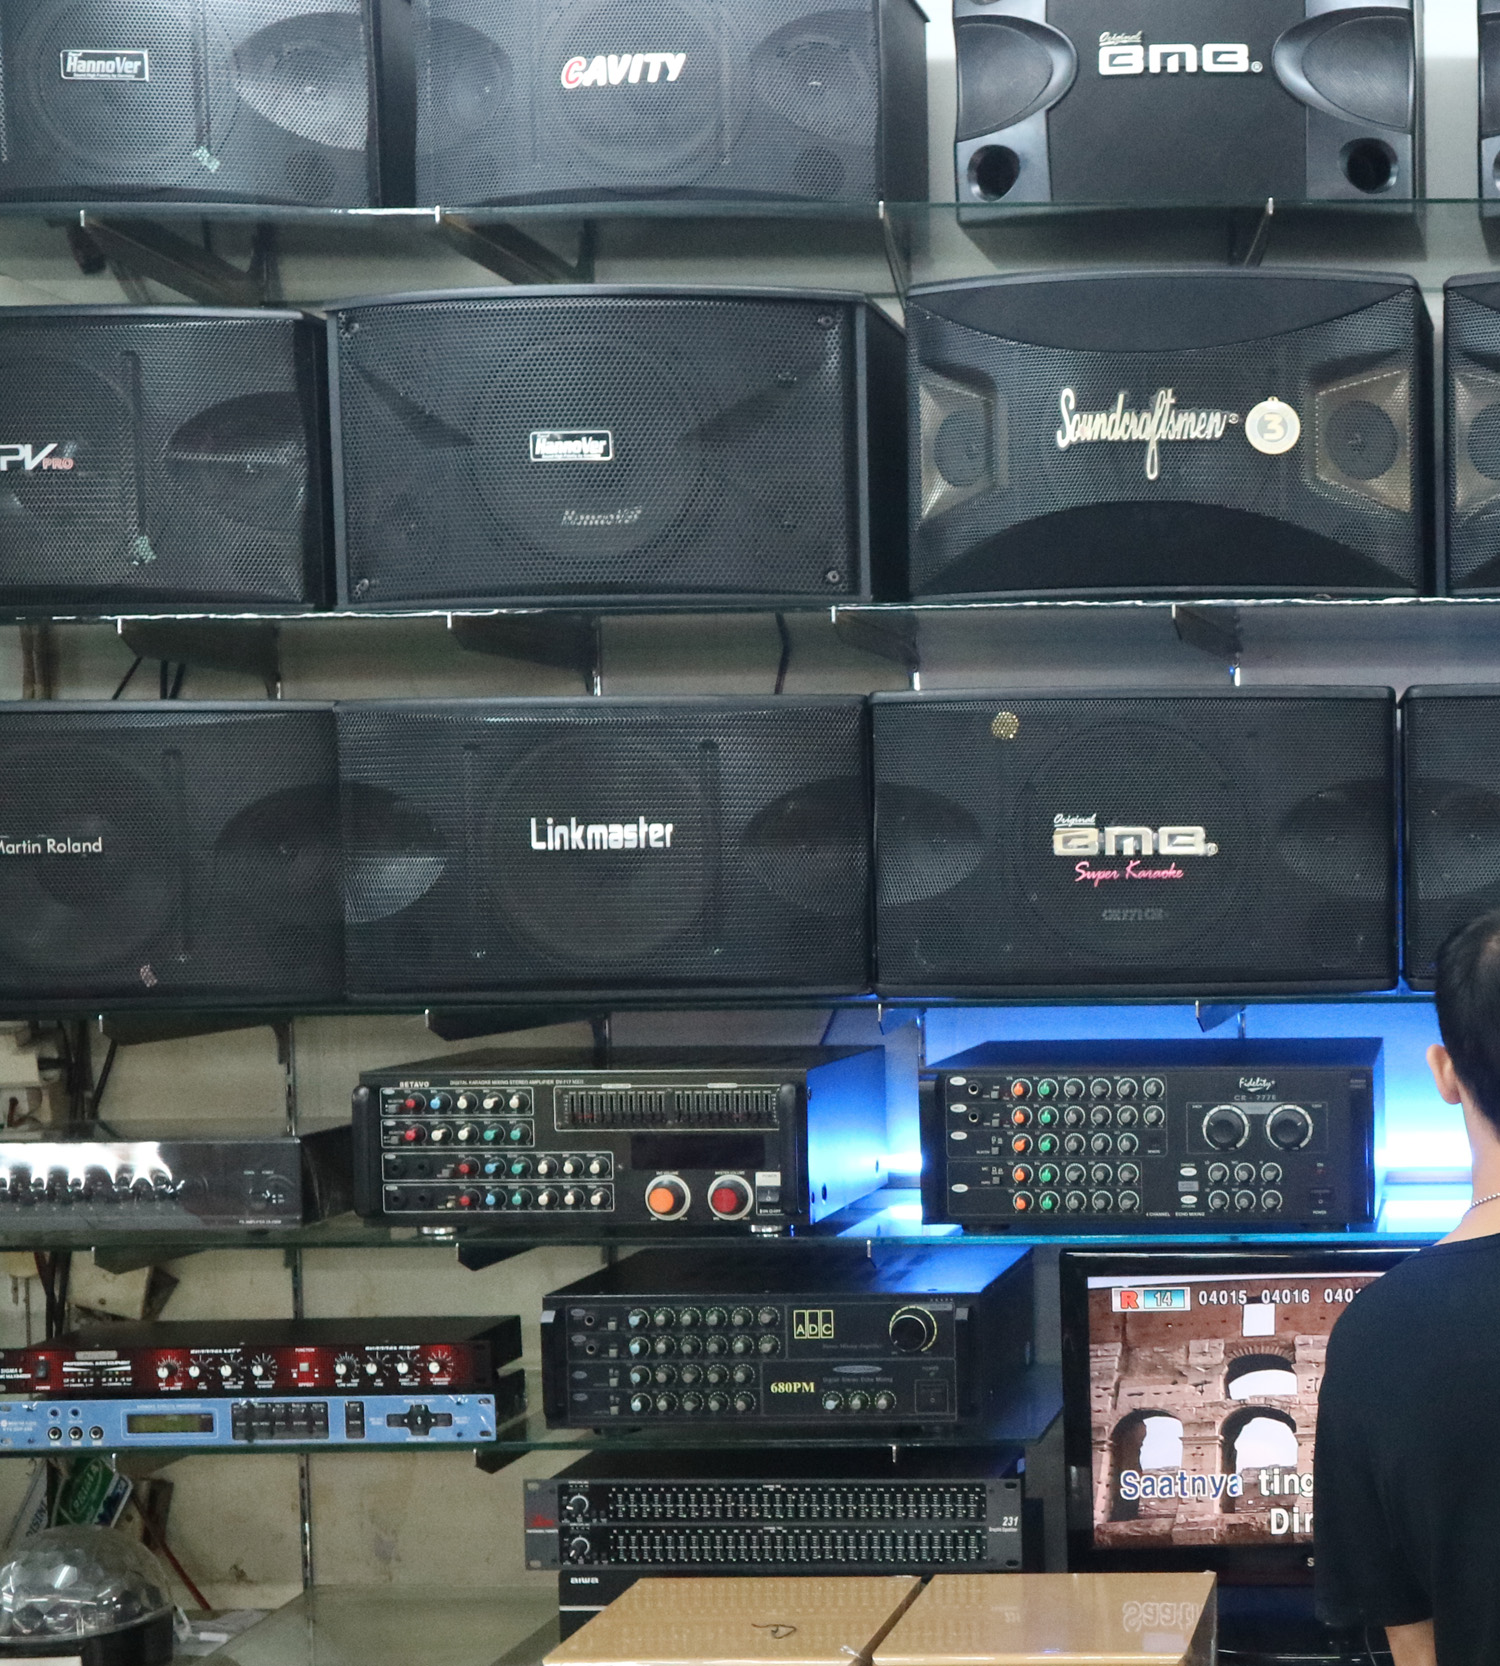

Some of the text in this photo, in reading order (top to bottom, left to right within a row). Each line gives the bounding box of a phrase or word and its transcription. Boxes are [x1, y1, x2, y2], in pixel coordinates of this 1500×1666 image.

[1099, 31, 1143, 46] Original
[66, 53, 142, 74] HannoVer
[561, 53, 686, 89] CAVITY
[1057, 388, 1228, 480] Soundcraftsmen
[1263, 414, 1285, 440] 3
[535, 434, 607, 455] HannoVer
[0, 443, 58, 471] PV
[42, 457, 74, 470] PRO
[1053, 813, 1097, 828] Original
[530, 816, 673, 850] Linkmaster
[47, 836, 102, 853] Roland
[1074, 860, 1184, 887] Super Karaoke
[1239, 1077, 1273, 1091] Fidelity
[1120, 1288, 1362, 1309] R 14 04015 04016 040
[770, 1381, 815, 1393] 680PM
[1120, 1468, 1314, 1500] Saatnya ting
[1003, 1516, 1019, 1526] 231
